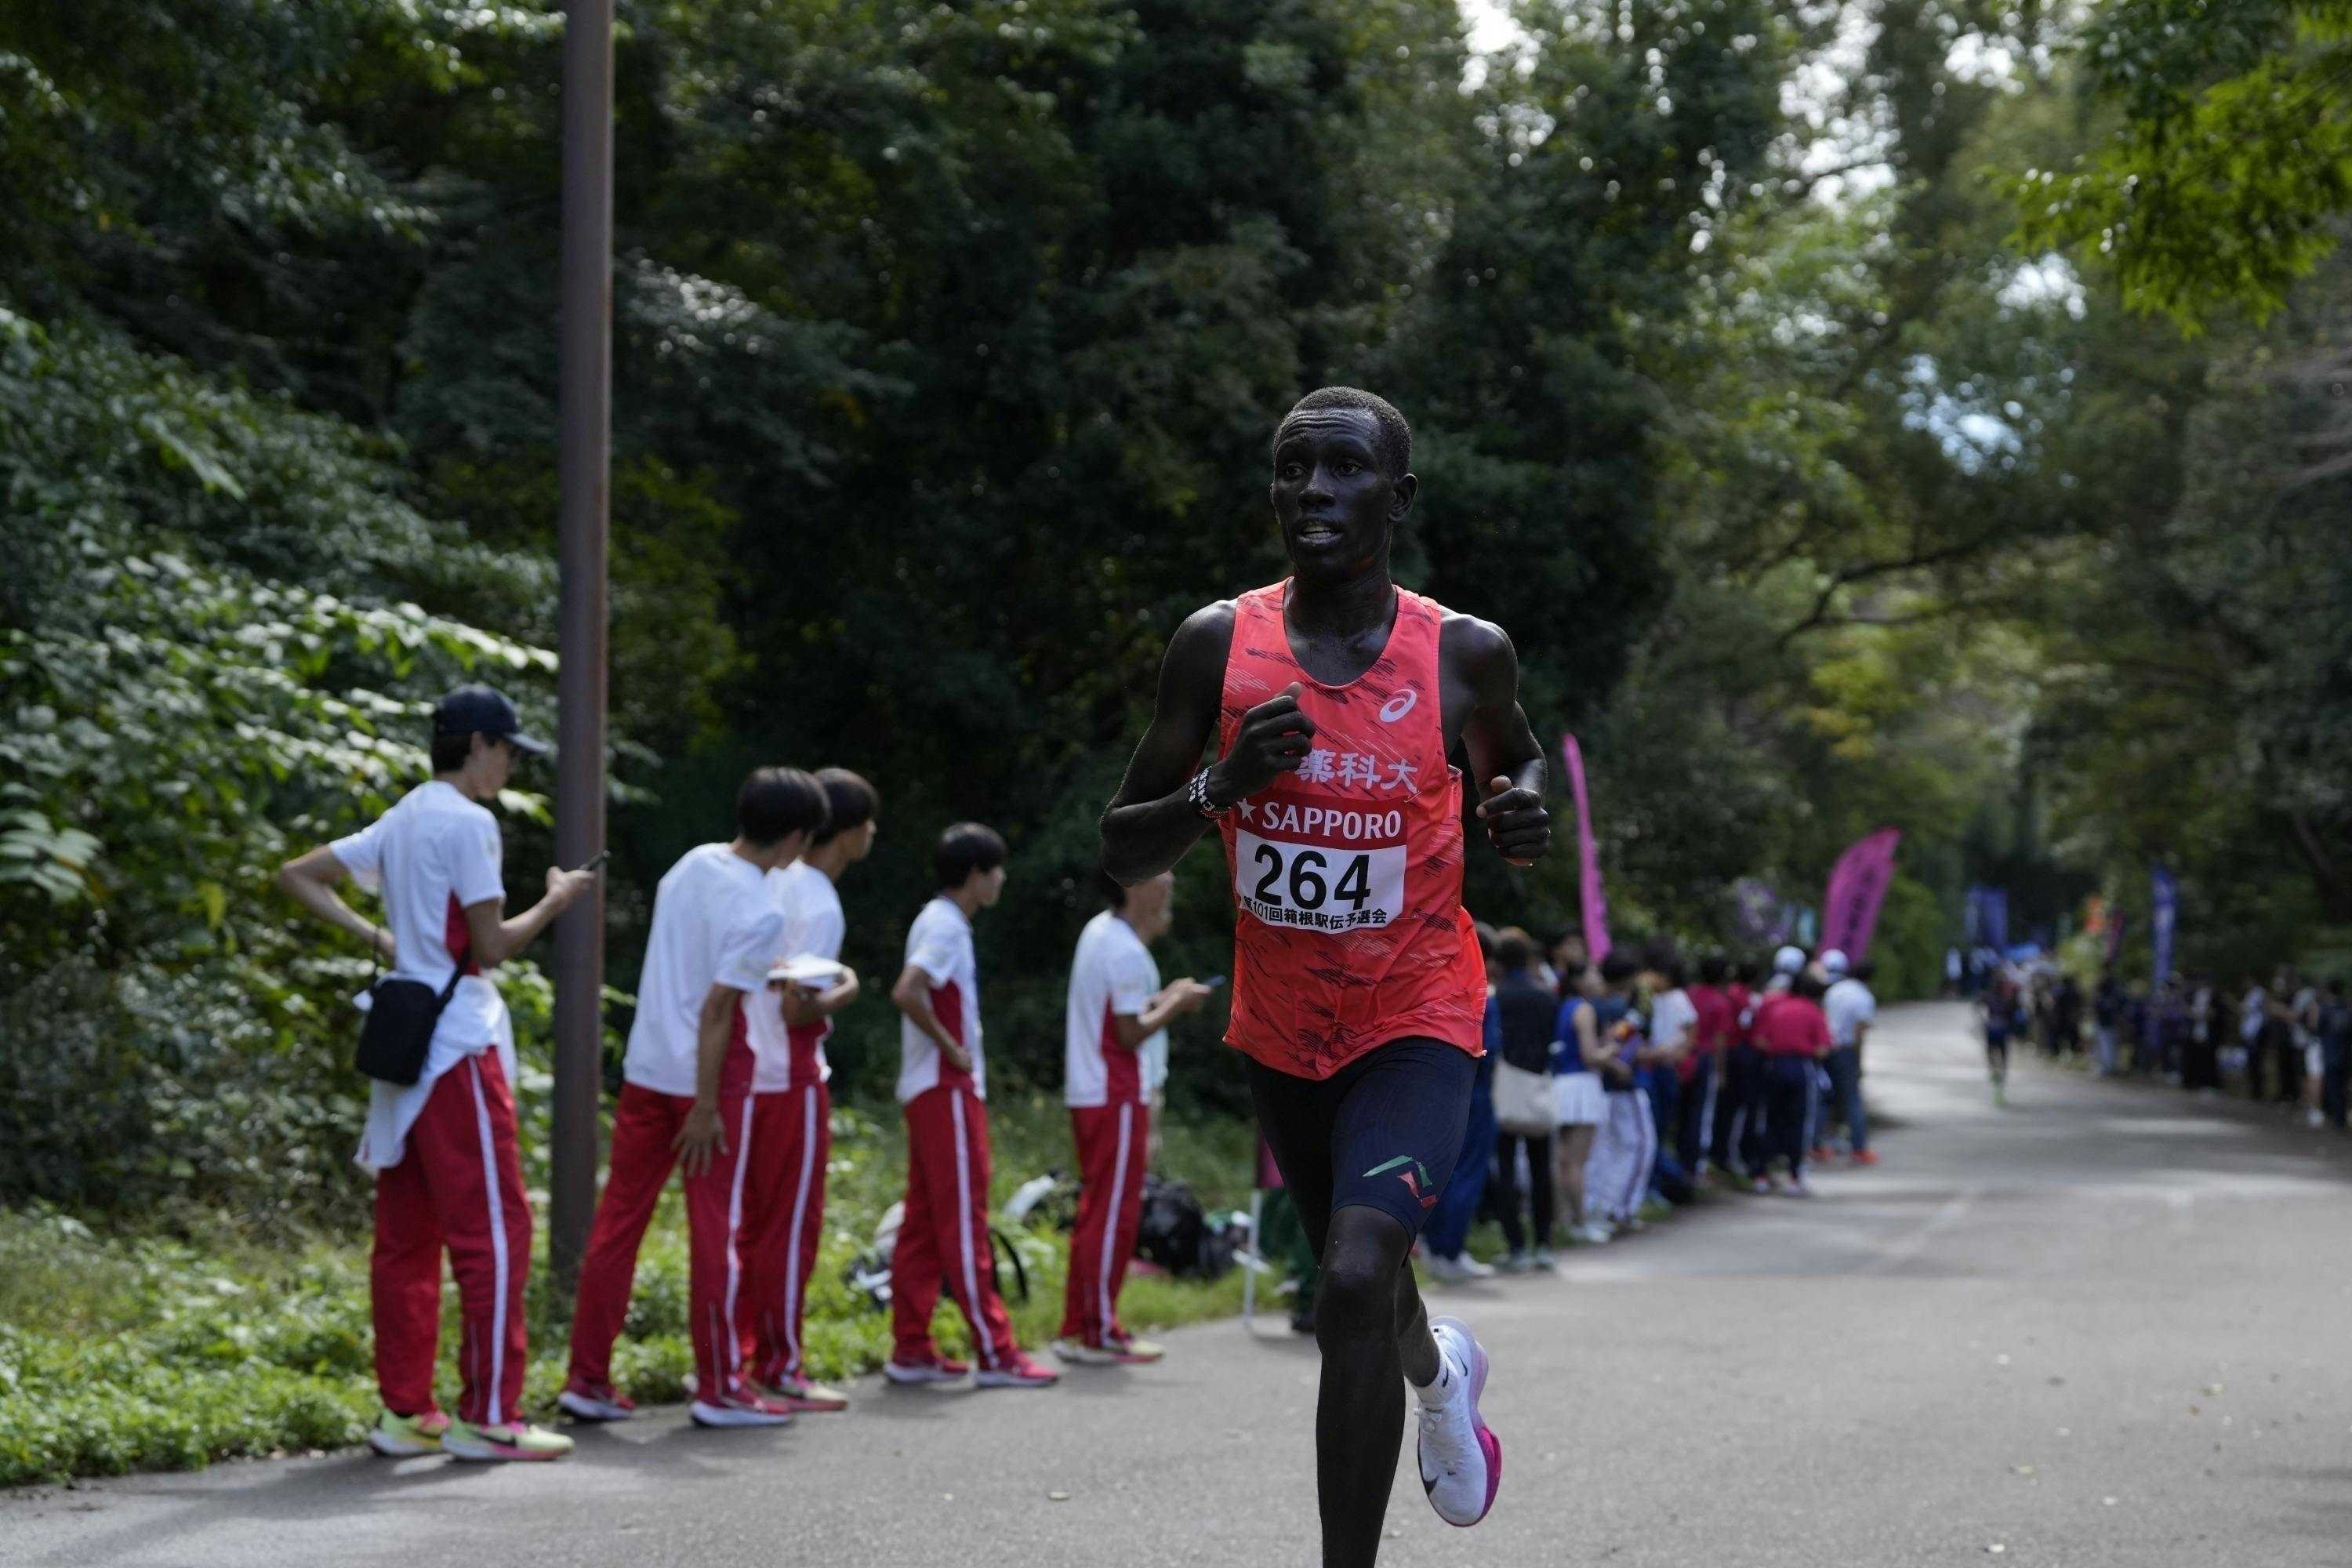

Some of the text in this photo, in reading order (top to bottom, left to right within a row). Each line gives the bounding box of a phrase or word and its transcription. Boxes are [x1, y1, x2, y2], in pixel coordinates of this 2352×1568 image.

[1261, 801, 1402, 840] SAPPORO
[1254, 844, 1371, 911] 264
[1243, 895, 1388, 931] 第101回箱根駅伝予選会
